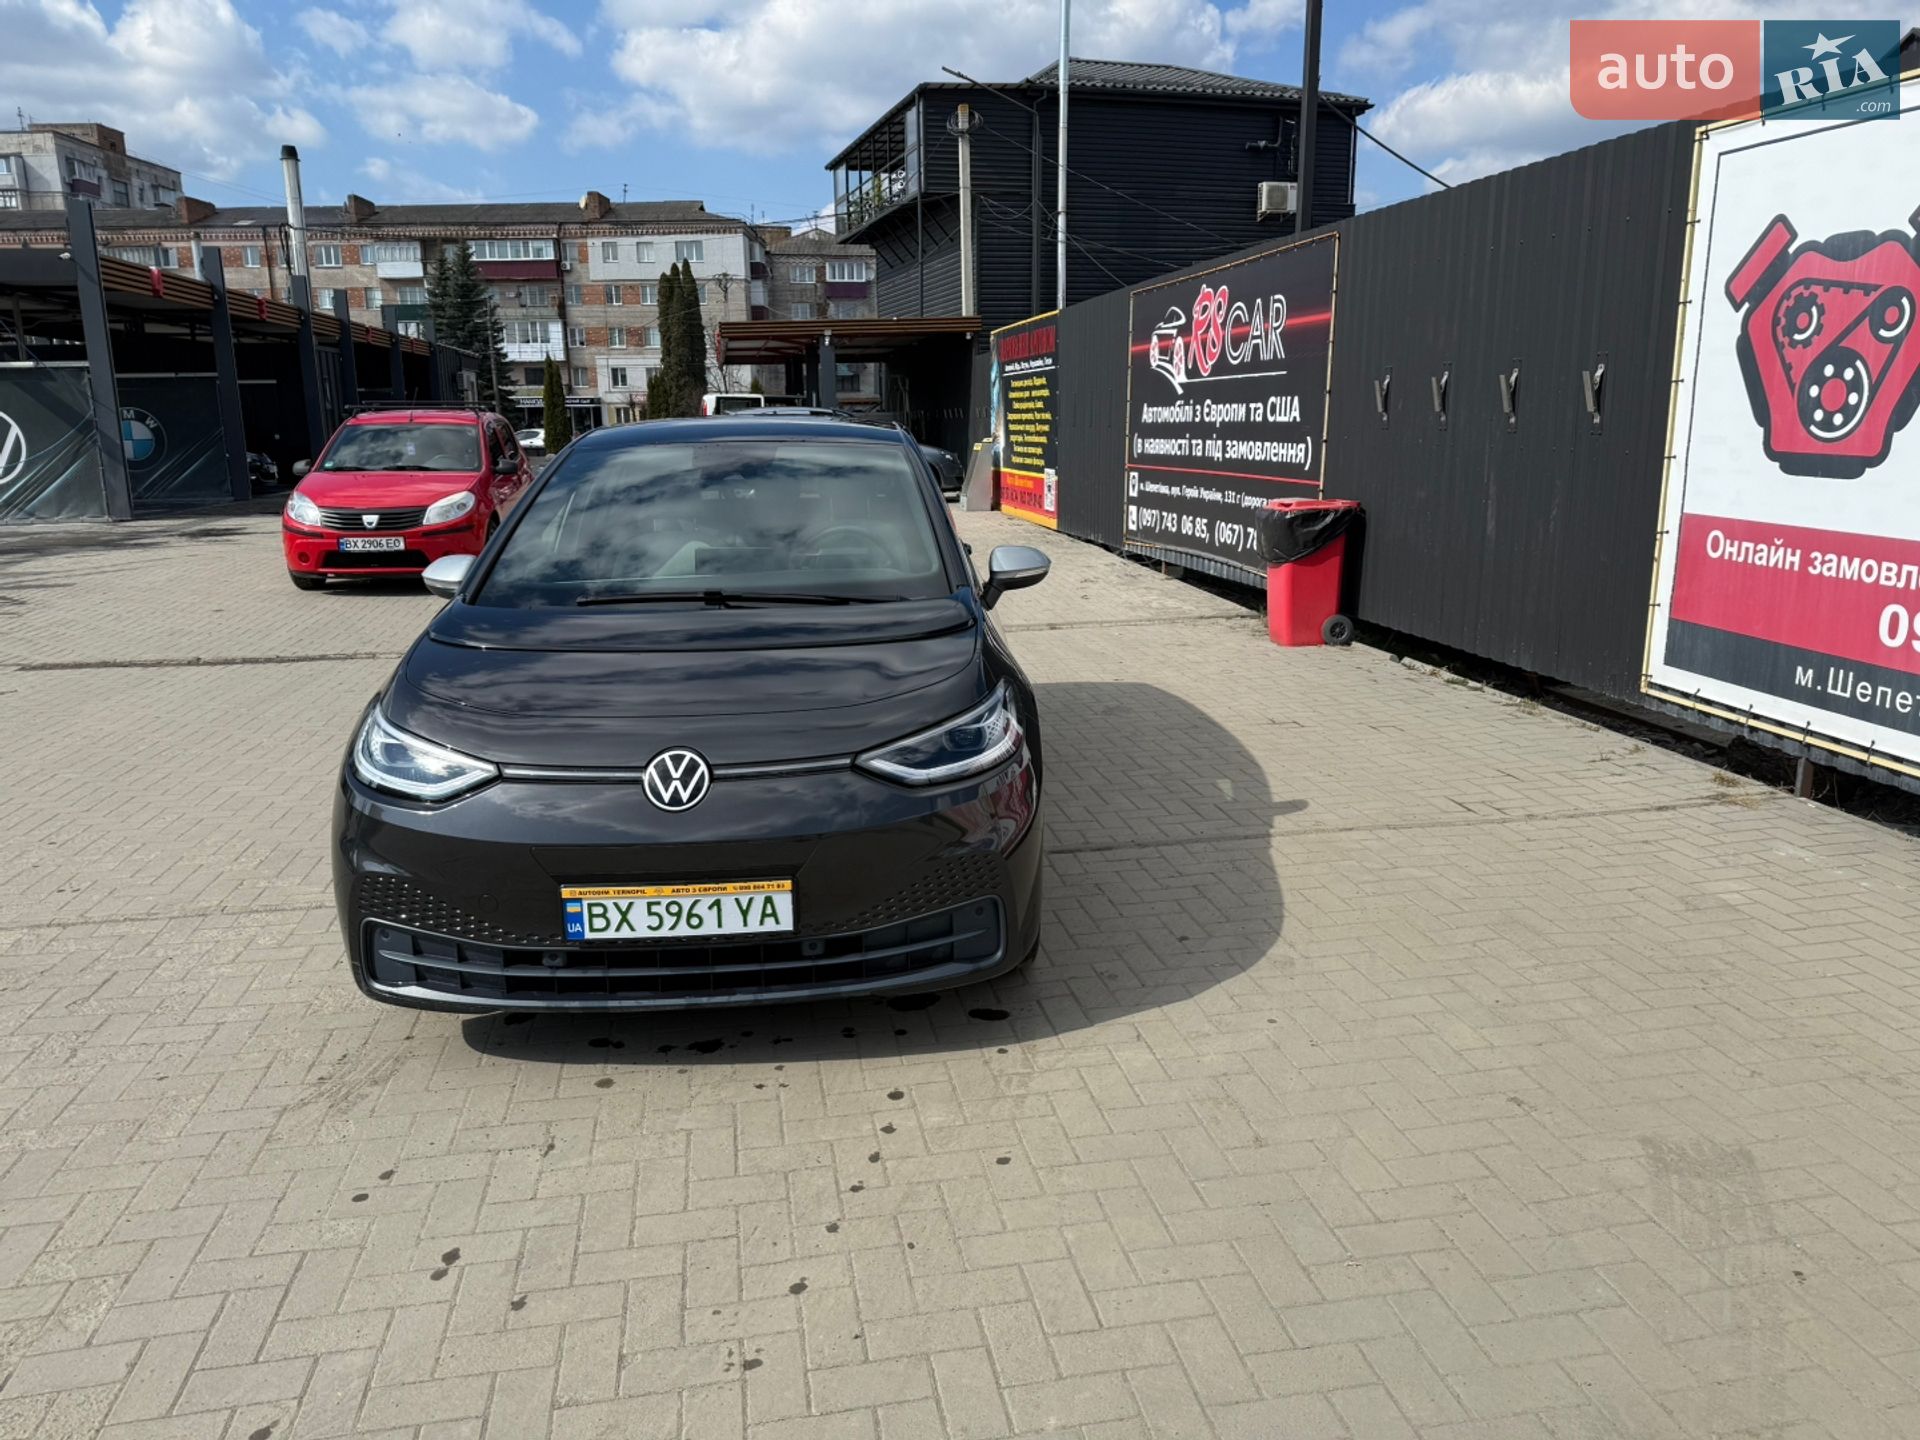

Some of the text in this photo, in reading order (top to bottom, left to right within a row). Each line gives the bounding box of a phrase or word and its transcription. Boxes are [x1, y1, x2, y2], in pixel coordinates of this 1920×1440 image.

[1141, 395, 1301, 428] Автомобілі з Європи та США
[1144, 433, 1190, 456] наявності
[1191, 438, 1203, 456] та
[1205, 433, 1223, 461] під
[1224, 436, 1312, 471] замовлення)
[1139, 506, 1160, 533] (097)
[1161, 511, 1178, 533] 743
[1181, 514, 1193, 536] 06
[1194, 517, 1210, 544] 85,
[1215, 520, 1244, 552] (067)
[1706, 530, 1920, 590] Онлайн замовл
[1795, 665, 1920, 718] м.Шепе
[567, 922, 582, 933] UA
[587, 895, 781, 933] BX 5961 YA
